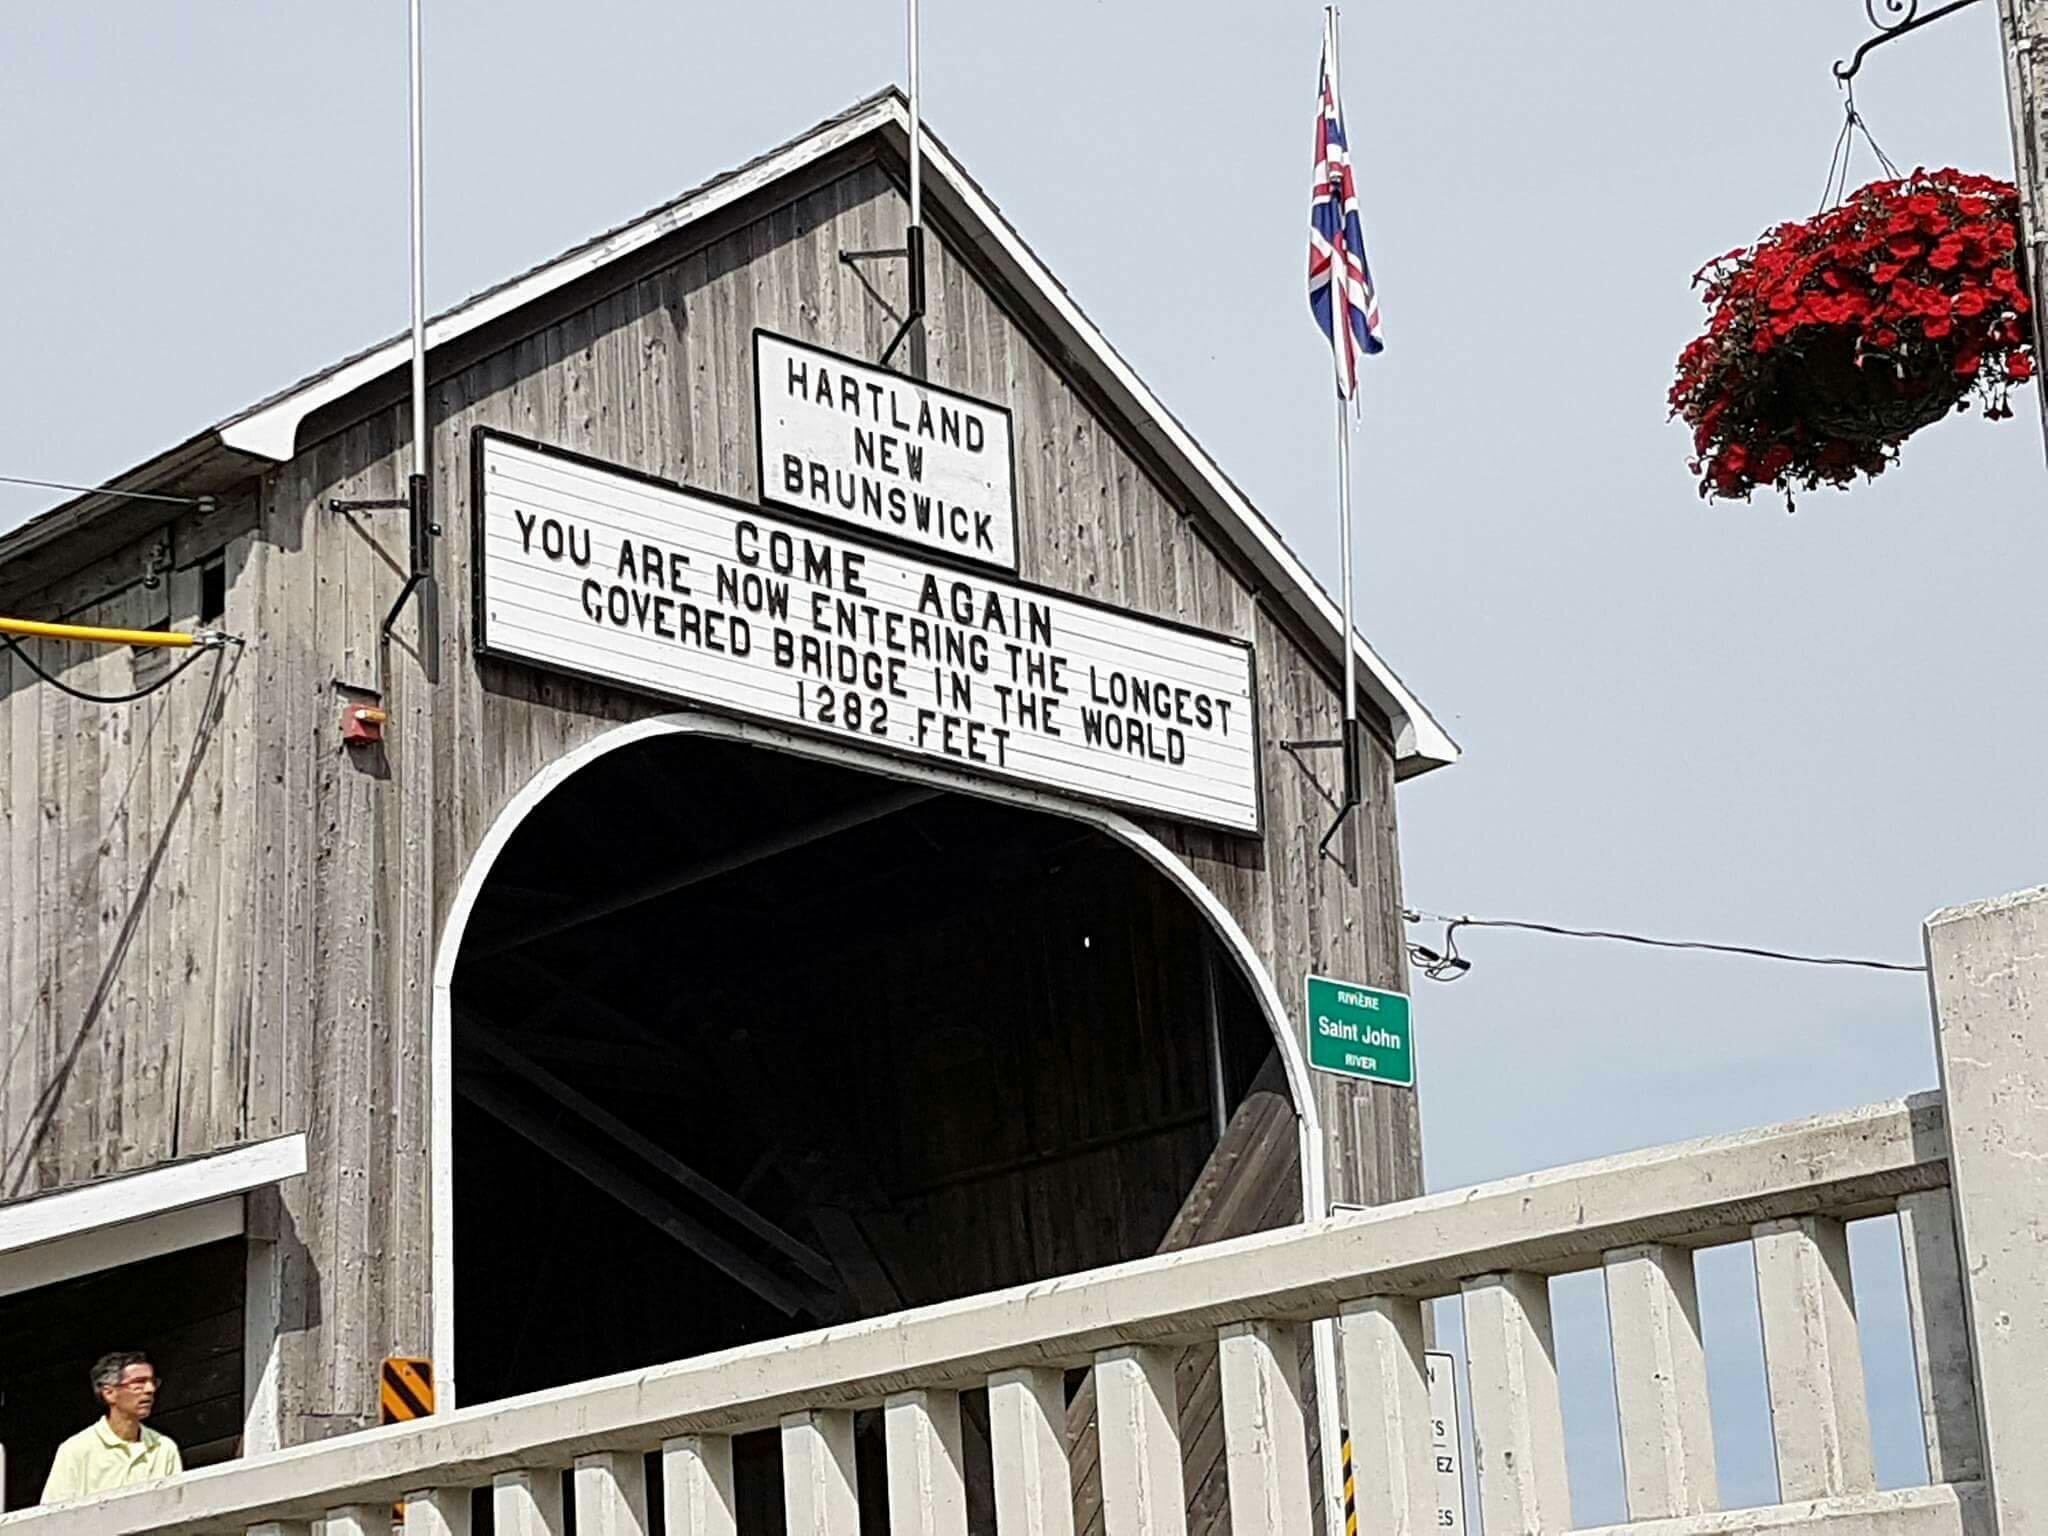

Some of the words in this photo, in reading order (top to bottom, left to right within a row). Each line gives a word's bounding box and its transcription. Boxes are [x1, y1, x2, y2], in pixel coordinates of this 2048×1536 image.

[788, 357, 985, 453] HARTLAND
[783, 453, 994, 552] BRUNSWICK
[855, 427, 923, 483] NEW
[514, 510, 591, 567] YOU
[617, 539, 691, 595] ARE
[716, 564, 789, 623] NOW
[811, 591, 989, 673] ENTERING
[1004, 643, 1068, 695] THE
[1090, 665, 1231, 736] LONGEST
[735, 520, 867, 598] COME
[917, 573, 1052, 648] AGAIN
[581, 578, 750, 657] COVERED
[773, 627, 907, 698] BRIDGE
[934, 667, 972, 713] IN
[994, 684, 1061, 736] THE
[1081, 706, 1185, 765] WORLD
[797, 680, 888, 735] 1282
[917, 708, 1010, 768] FEET
[1318, 1015, 1358, 1042] Saint
[1361, 1025, 1401, 1049] John
[1345, 1053, 1377, 1071] RIVER
